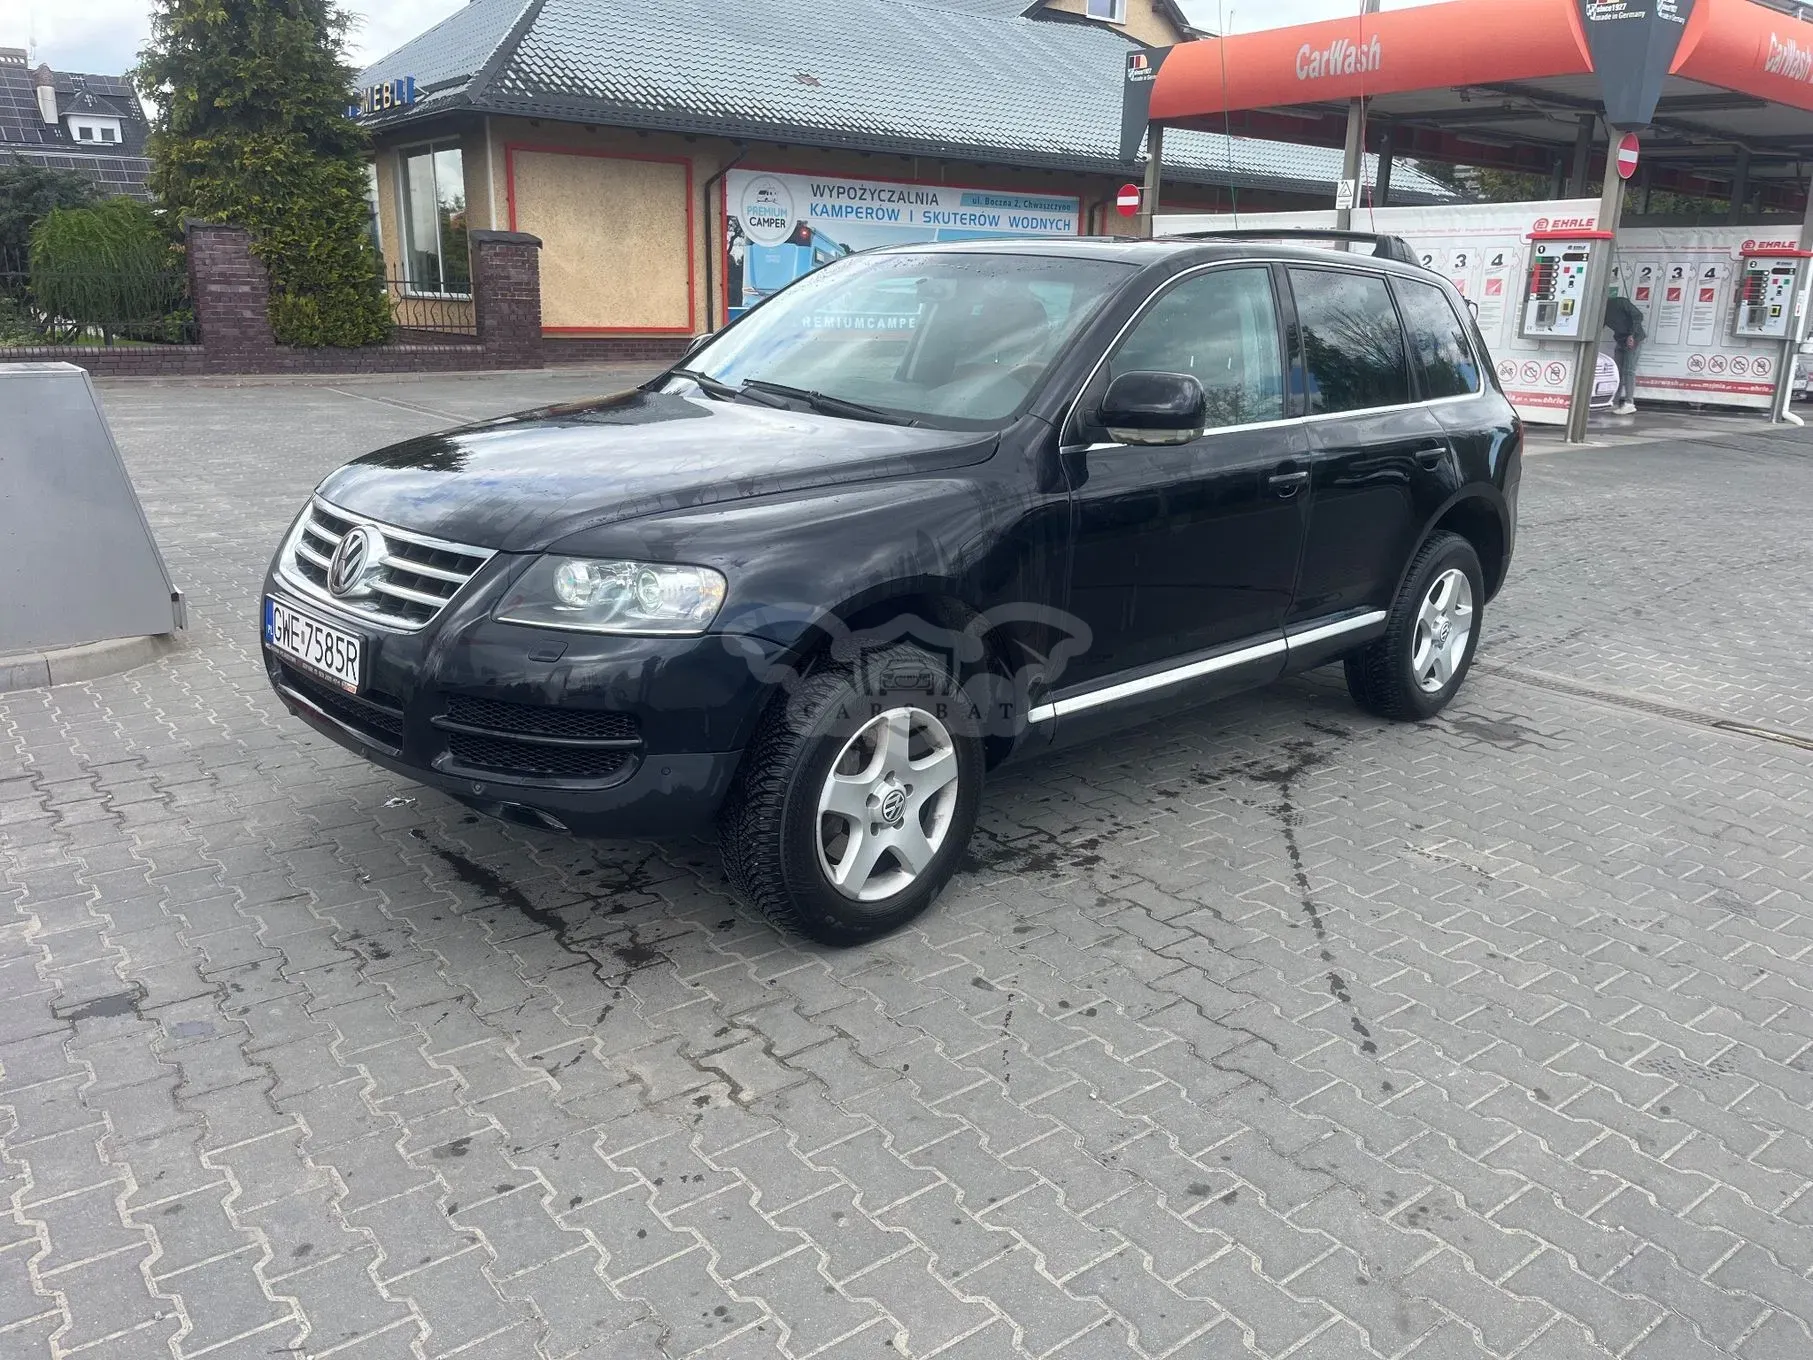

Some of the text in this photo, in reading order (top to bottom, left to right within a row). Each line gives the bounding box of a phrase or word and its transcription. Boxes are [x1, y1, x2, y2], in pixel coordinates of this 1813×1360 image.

[1618, 11, 1645, 19] Germany
[1295, 34, 1382, 81] CarWash
[1764, 32, 1812, 82] CarWash
[810, 183, 939, 206] WYPOŻYCZALNIA
[984, 198, 1012, 207] Boczna
[747, 205, 787, 217] PREMIUM
[810, 203, 1071, 231] KAMPERÓW I SKUTERÓW WODNYCH
[749, 216, 786, 229] CAMPER
[1551, 218, 1595, 229] EHRLE
[1757, 241, 1797, 249] EHRLE
[1422, 253, 1503, 268] 2 3 4
[1640, 267, 1652, 278] 2
[1672, 267, 1683, 279] 3
[1704, 267, 1716, 278] 4
[274, 607, 299, 653] GWE
[305, 621, 357, 681] 7585R
